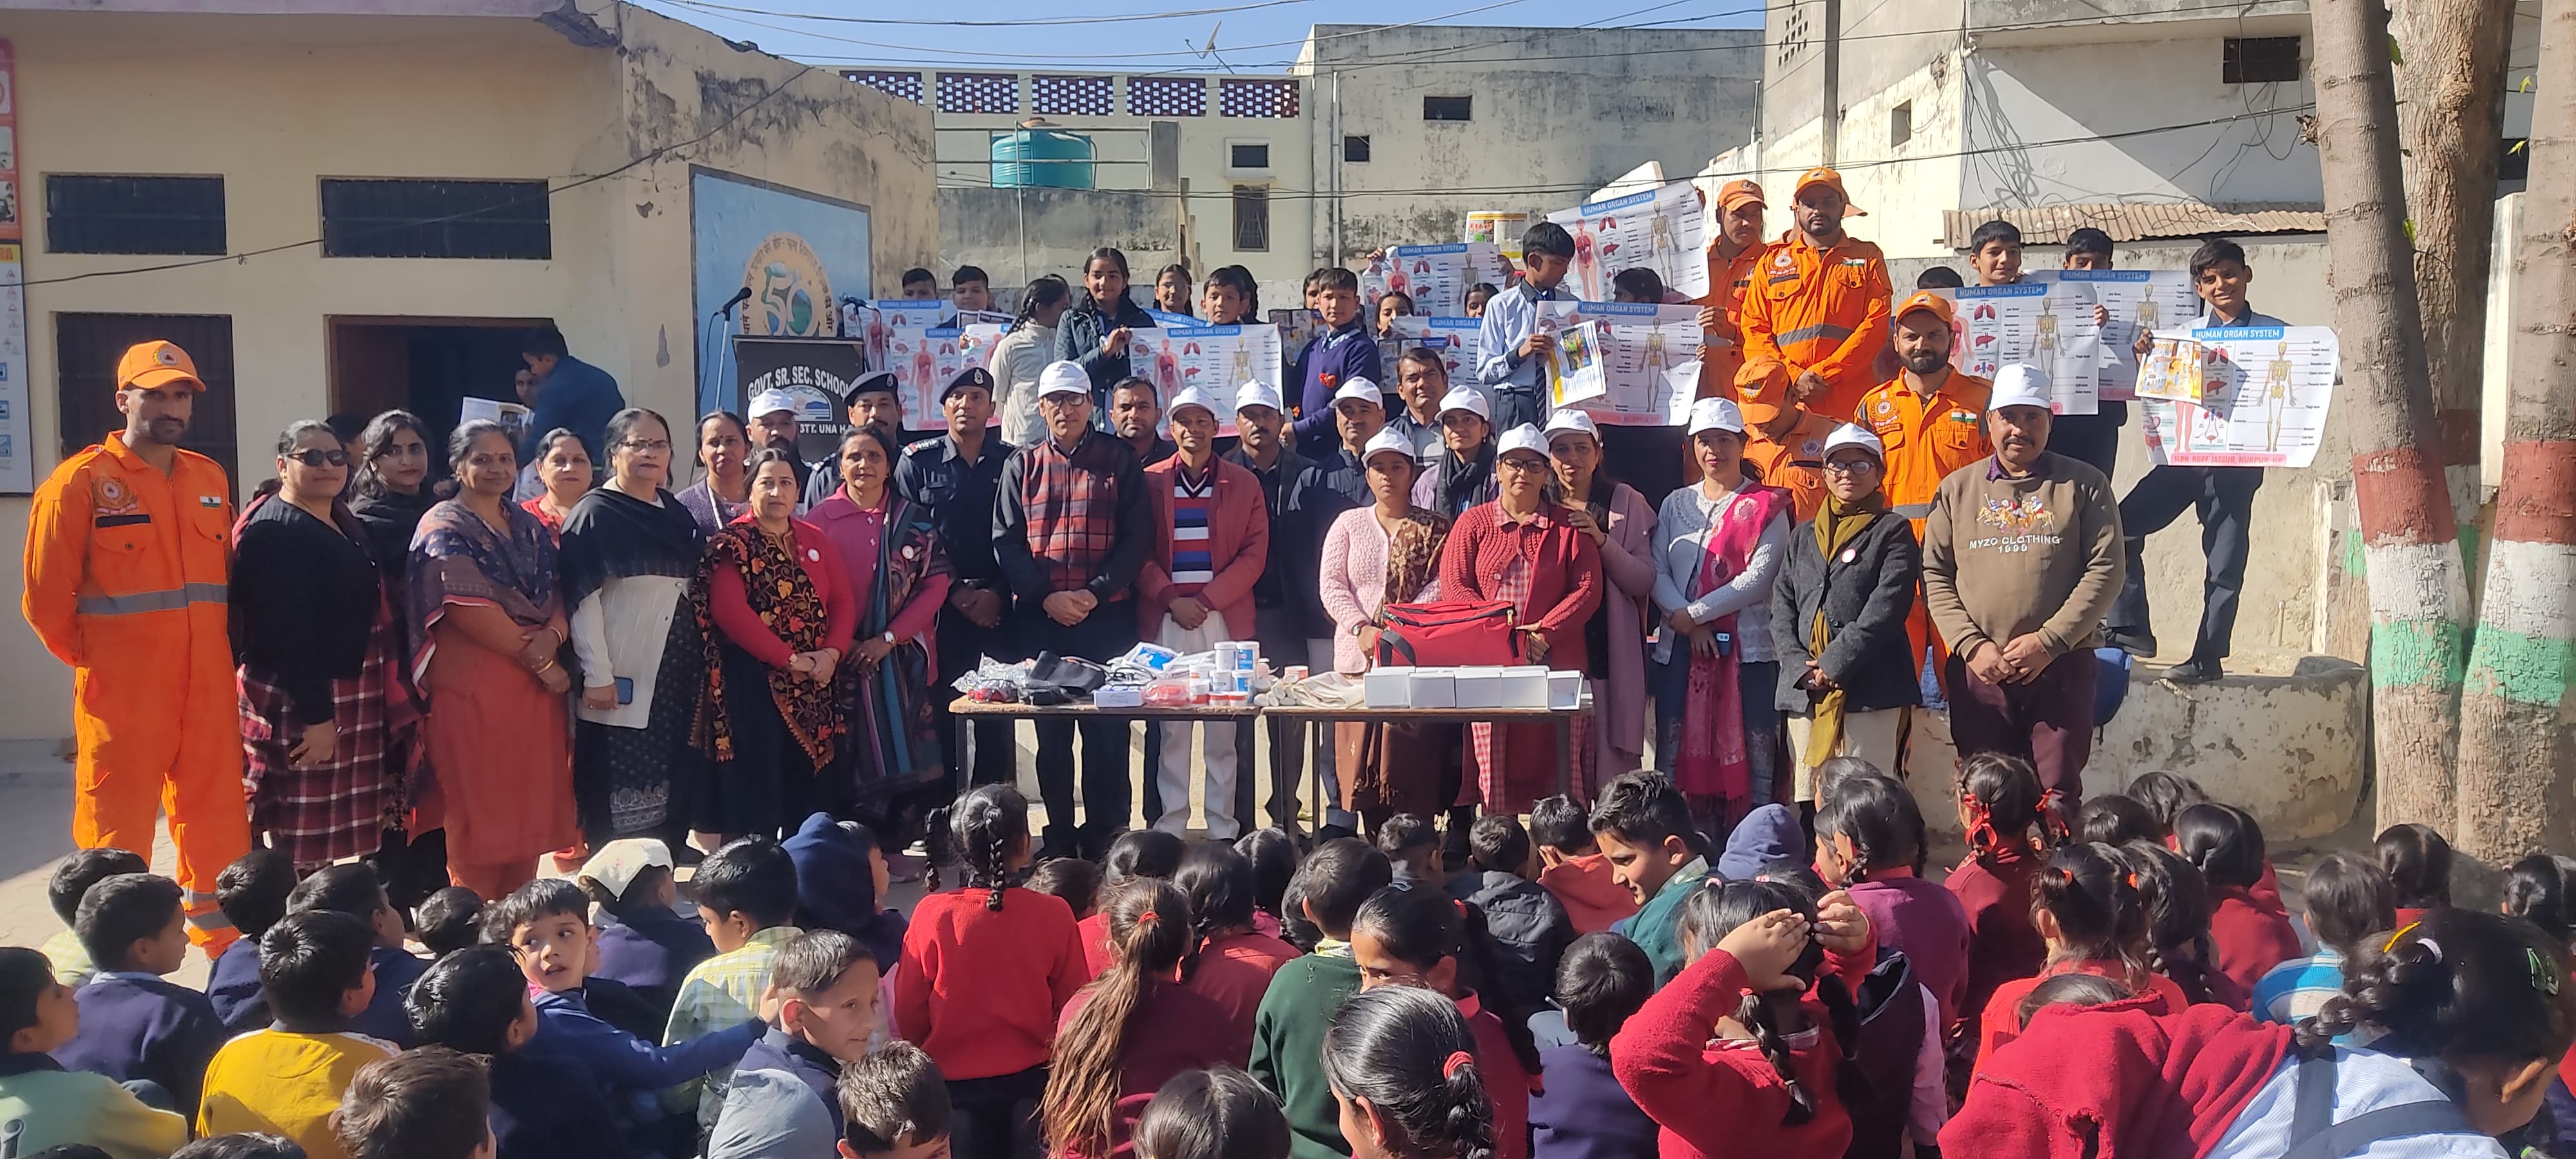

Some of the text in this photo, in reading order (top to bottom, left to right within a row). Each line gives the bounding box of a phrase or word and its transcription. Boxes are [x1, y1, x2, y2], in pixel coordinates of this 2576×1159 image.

[1584, 193, 1652, 214] HUMAN ORGAN SYSTEM
[1959, 285, 2043, 296] HUMAN ORGAN SYSTEM
[2196, 329, 2279, 339] HUMAN ORGAN SYSTEM
[748, 371, 773, 402] GOVT.
[775, 367, 790, 386] SR.
[792, 365, 813, 385] SEC.
[800, 423, 817, 433] STT.
[819, 424, 838, 434] UNA
[1969, 534, 2061, 550] MYZO CLOTHING
[1998, 544, 2028, 554] 1999
